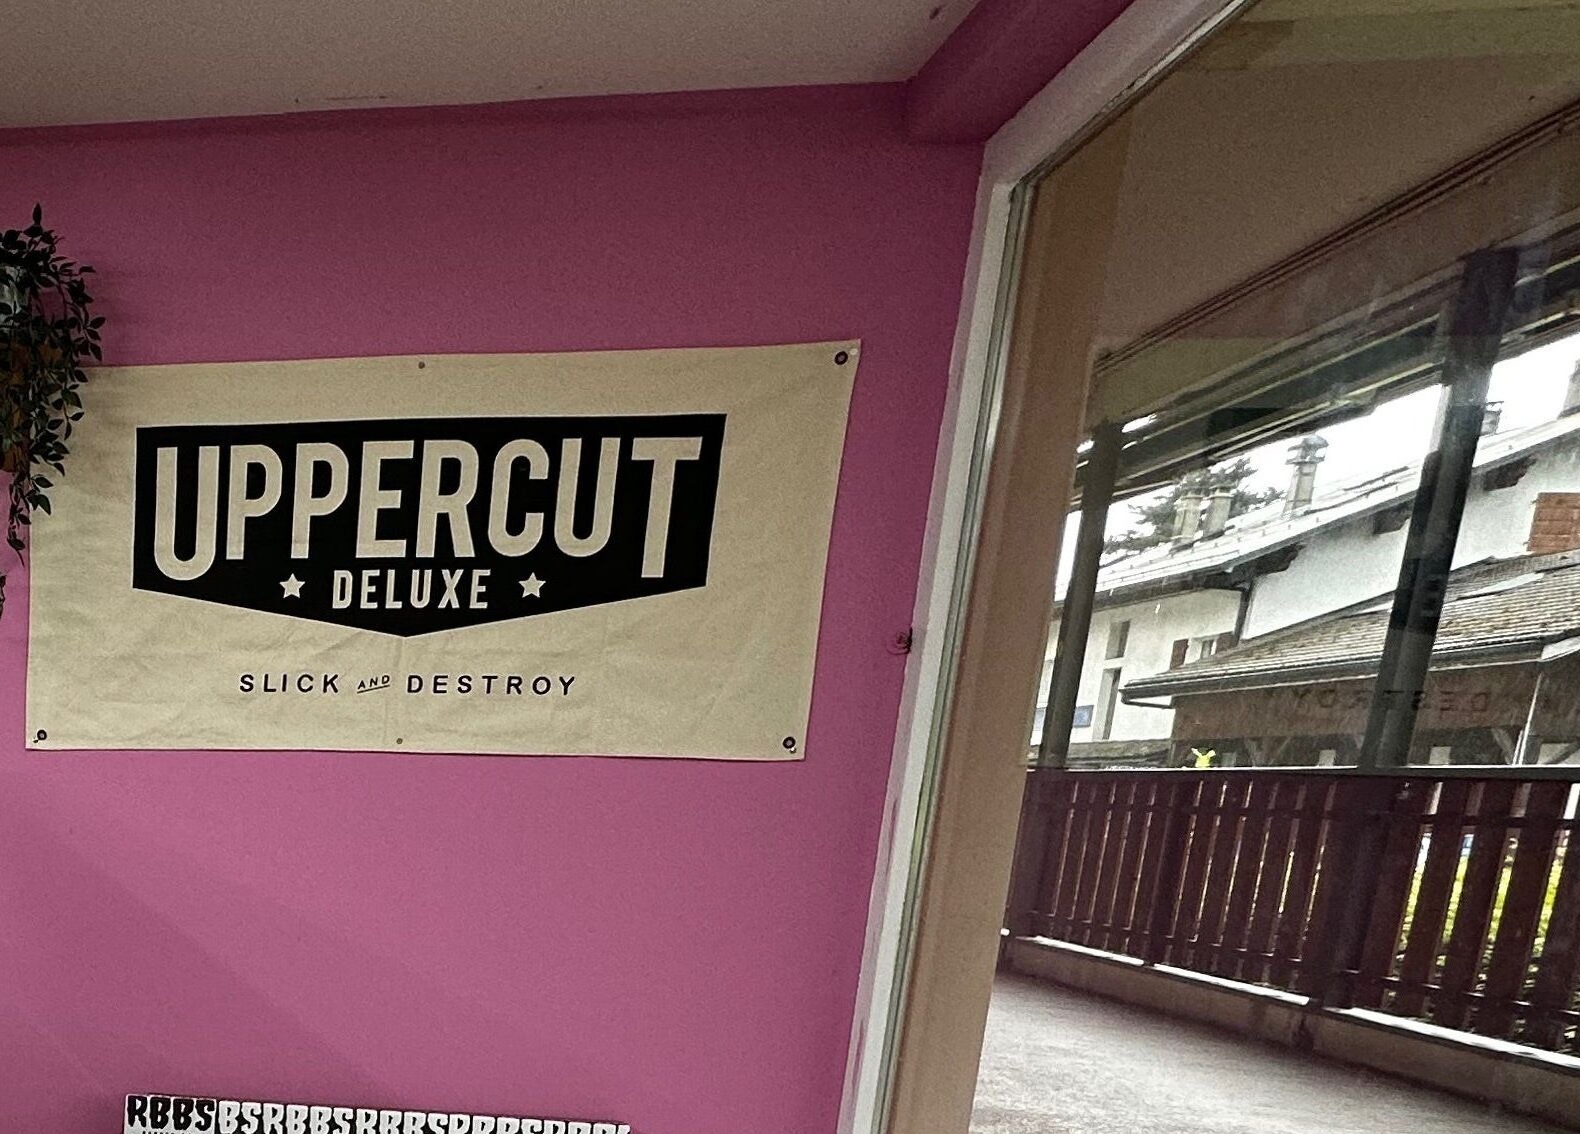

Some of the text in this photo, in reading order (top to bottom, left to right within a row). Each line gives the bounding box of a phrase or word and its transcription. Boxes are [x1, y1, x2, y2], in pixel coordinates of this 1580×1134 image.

[155, 437, 703, 580] UPPERCUT
[332, 569, 492, 610] DELUXE
[239, 672, 577, 698] SLICK AND DESTROY
[126, 1095, 217, 1132] RBBS
